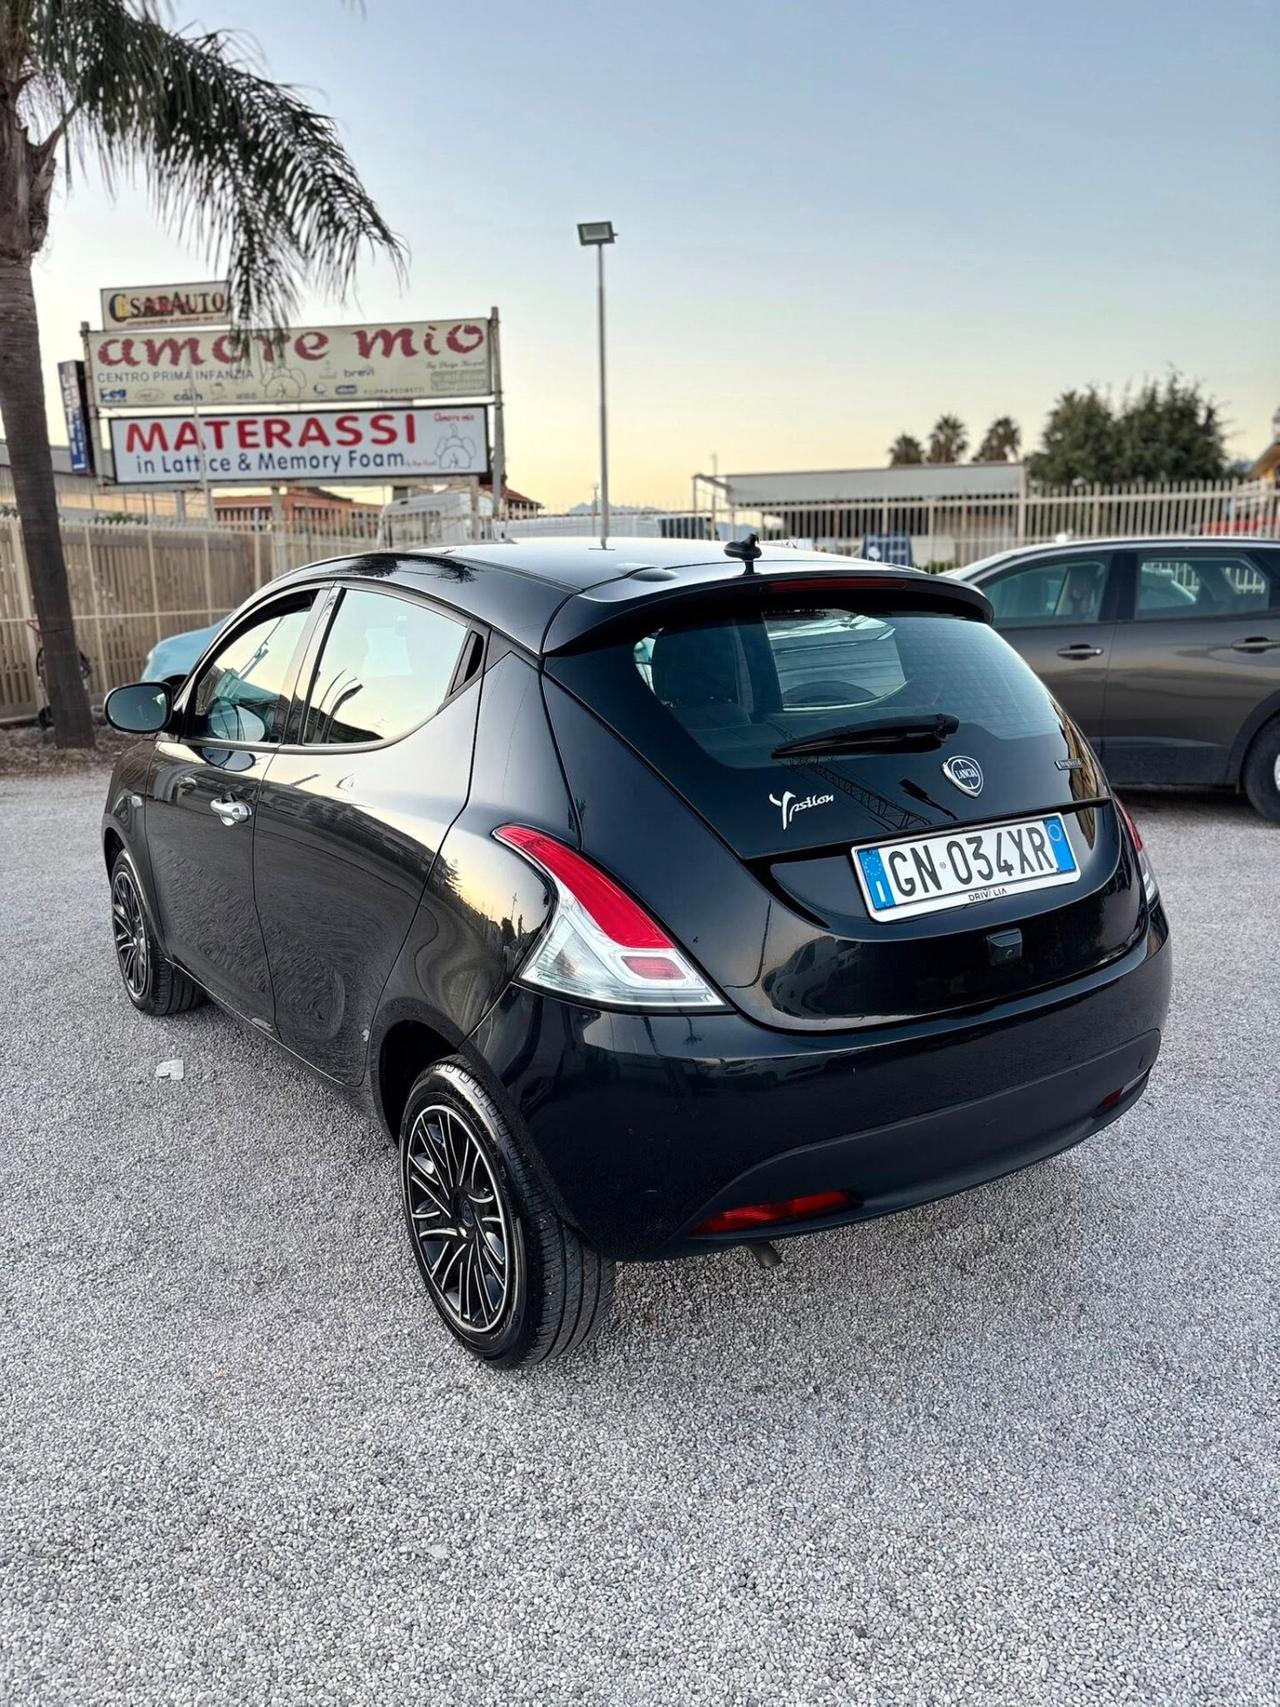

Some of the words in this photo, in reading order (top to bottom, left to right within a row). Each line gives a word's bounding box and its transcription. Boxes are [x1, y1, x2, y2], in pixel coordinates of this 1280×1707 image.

[97, 331, 329, 368] amore
[97, 372, 151, 382] CENTRO
[153, 371, 193, 381] PRIMA
[126, 413, 416, 453] MATERASSI
[137, 455, 155, 474] in
[238, 453, 251, 472] &
[258, 450, 342, 473] Memory
[349, 449, 405, 468] Foam
[768, 791, 835, 831] Ypsilon
[888, 844, 943, 897] GN
[947, 826, 1055, 885] 034XR
